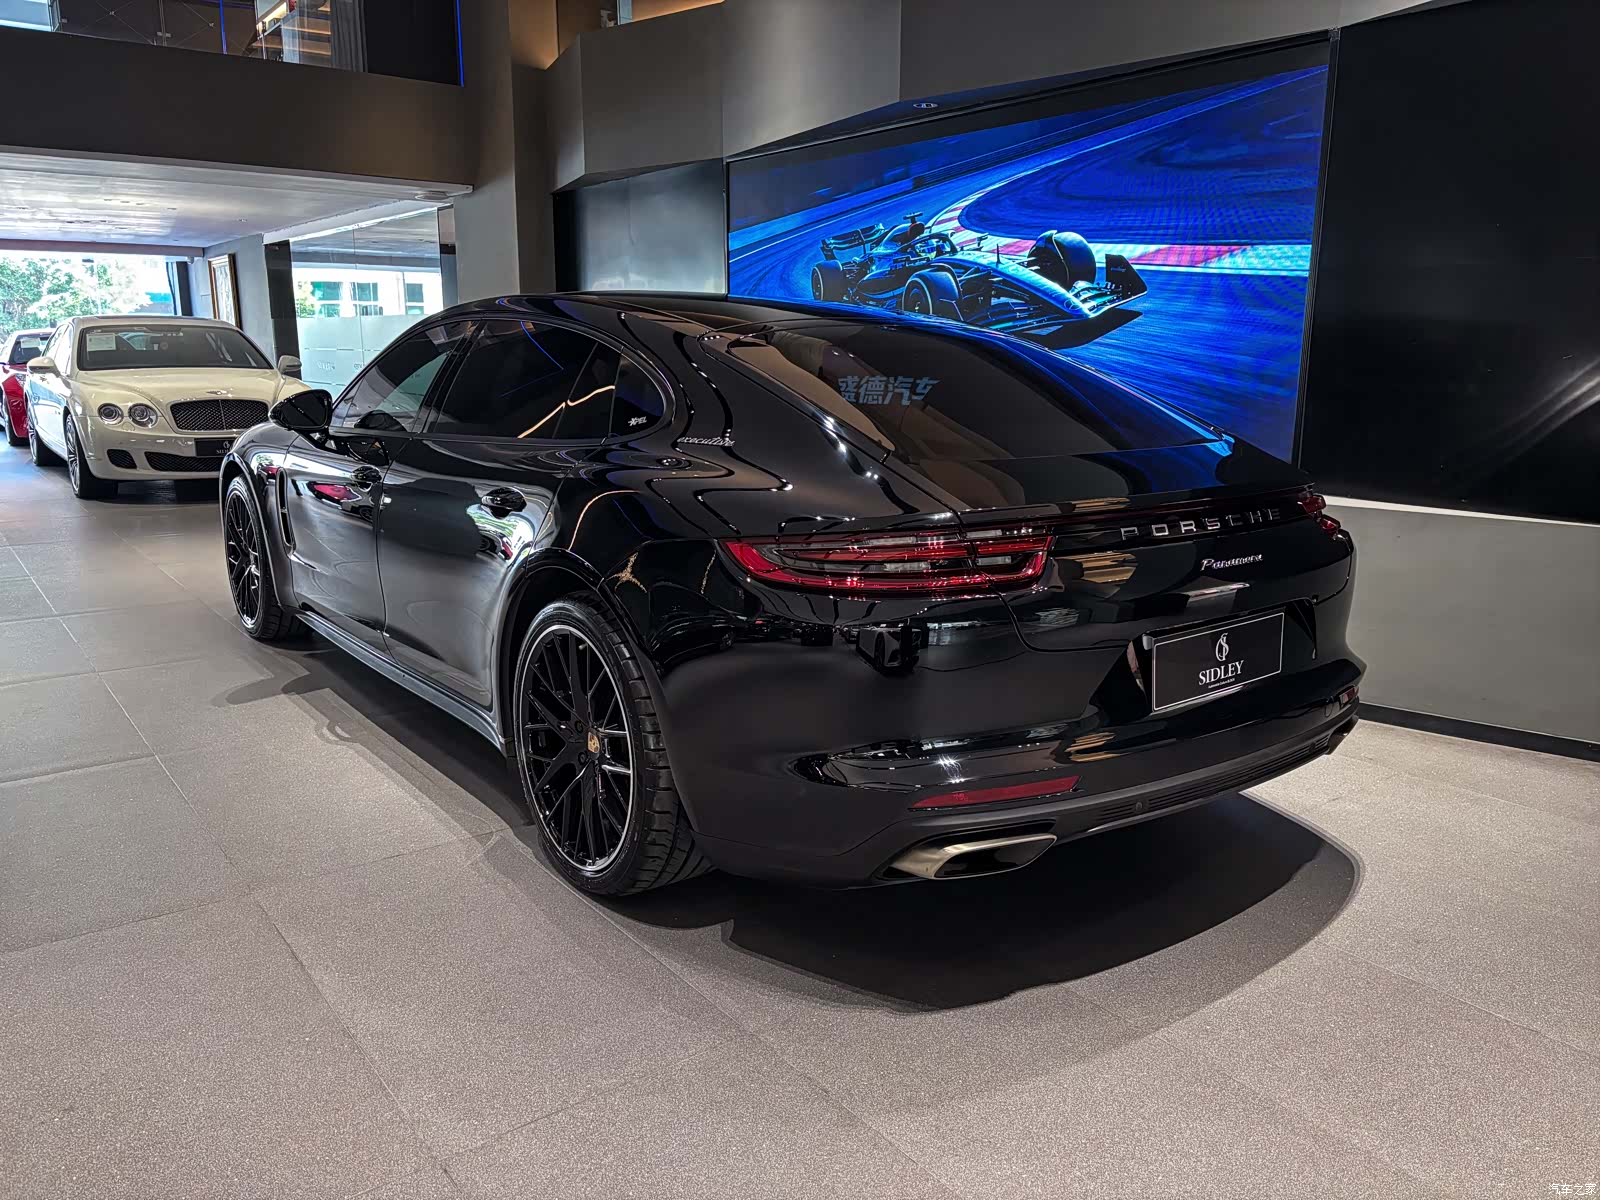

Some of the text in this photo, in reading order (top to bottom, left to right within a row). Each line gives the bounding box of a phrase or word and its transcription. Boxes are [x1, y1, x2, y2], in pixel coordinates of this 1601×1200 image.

[627, 416, 648, 427] XPEL
[676, 436, 736, 447] executive
[1120, 508, 1281, 540] PORSCHE
[1200, 553, 1263, 571] Panamera
[1198, 660, 1244, 686] SIDLEY
